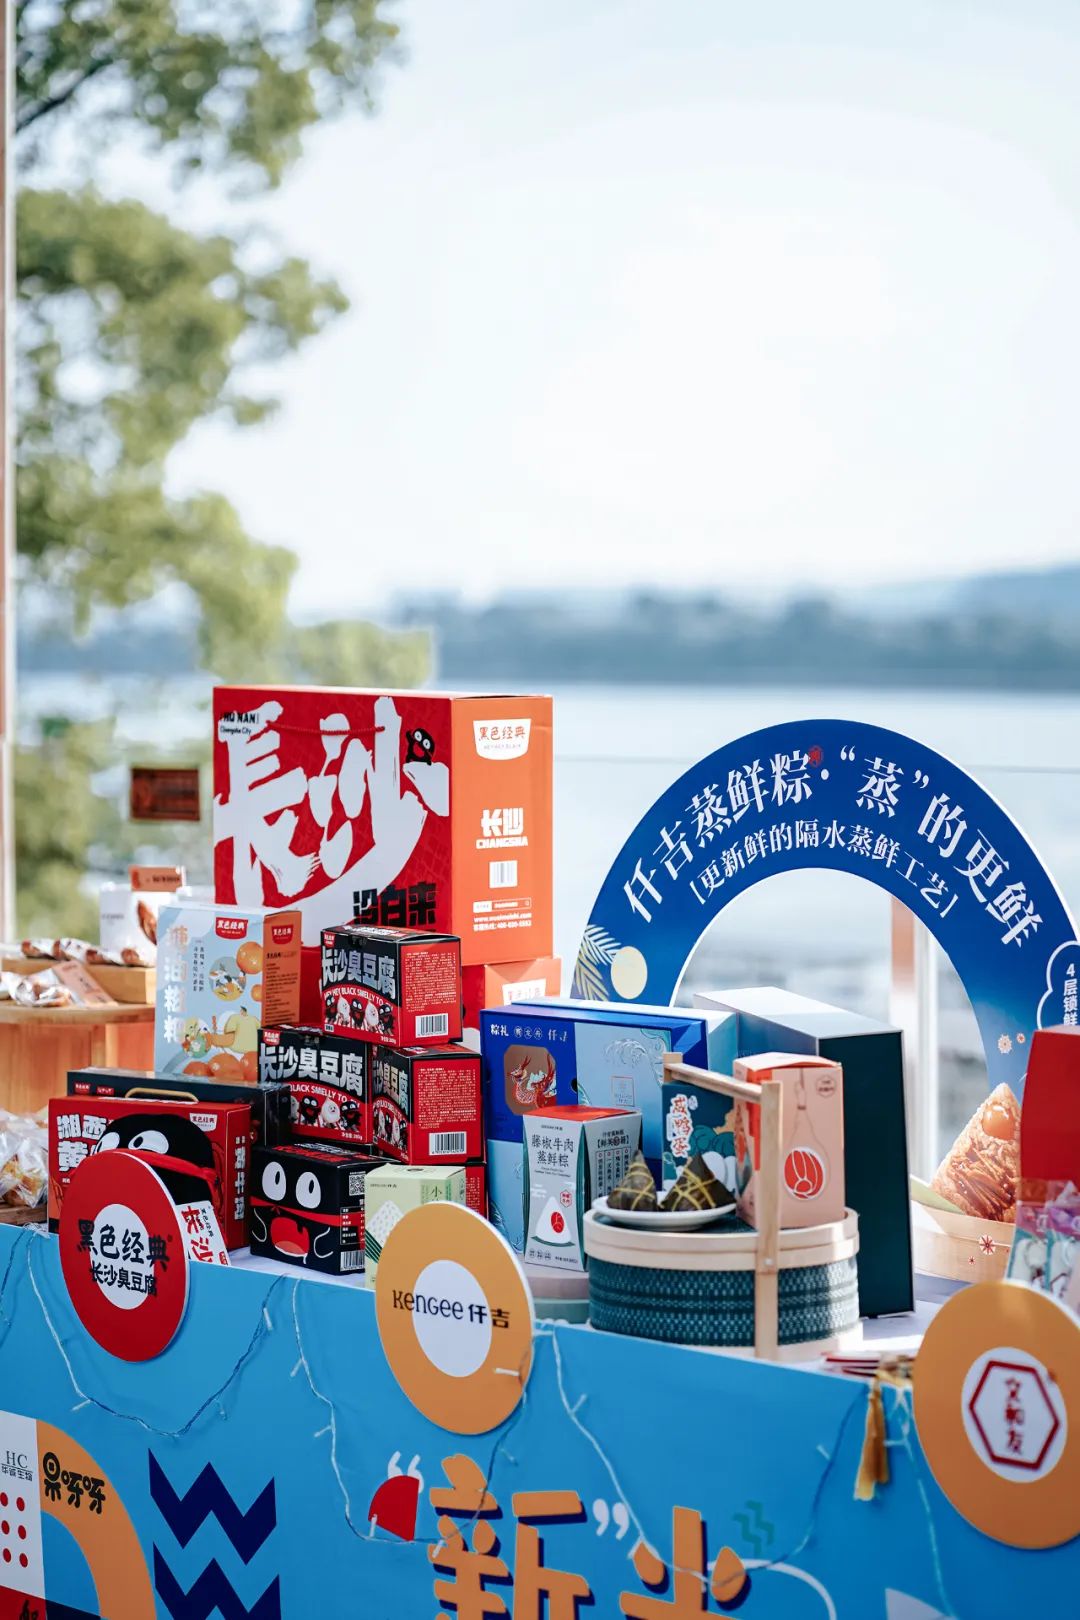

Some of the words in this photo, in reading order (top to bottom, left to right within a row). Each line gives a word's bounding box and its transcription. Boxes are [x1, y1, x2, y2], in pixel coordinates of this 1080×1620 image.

[479, 725, 526, 741] 黑色经典
[481, 808, 524, 837] 长沙
[322, 946, 396, 1000] 长沙臭豆腐
[490, 1024, 509, 1037] 粽礼
[259, 1043, 363, 1097] 长沙臭豆腐
[531, 1133, 574, 1153] 藤椒牛肉
[537, 1151, 569, 1168] 蒸鲜粽
[77, 1219, 170, 1272] 黑色经典
[90, 1260, 157, 1296] 长沙臭豆腐
[468, 1304, 510, 1328] 仟吉
[1005, 1379, 1024, 1455] 文和友
[6, 1450, 28, 1469] HC
[43, 1452, 106, 1515] 果呀呀
